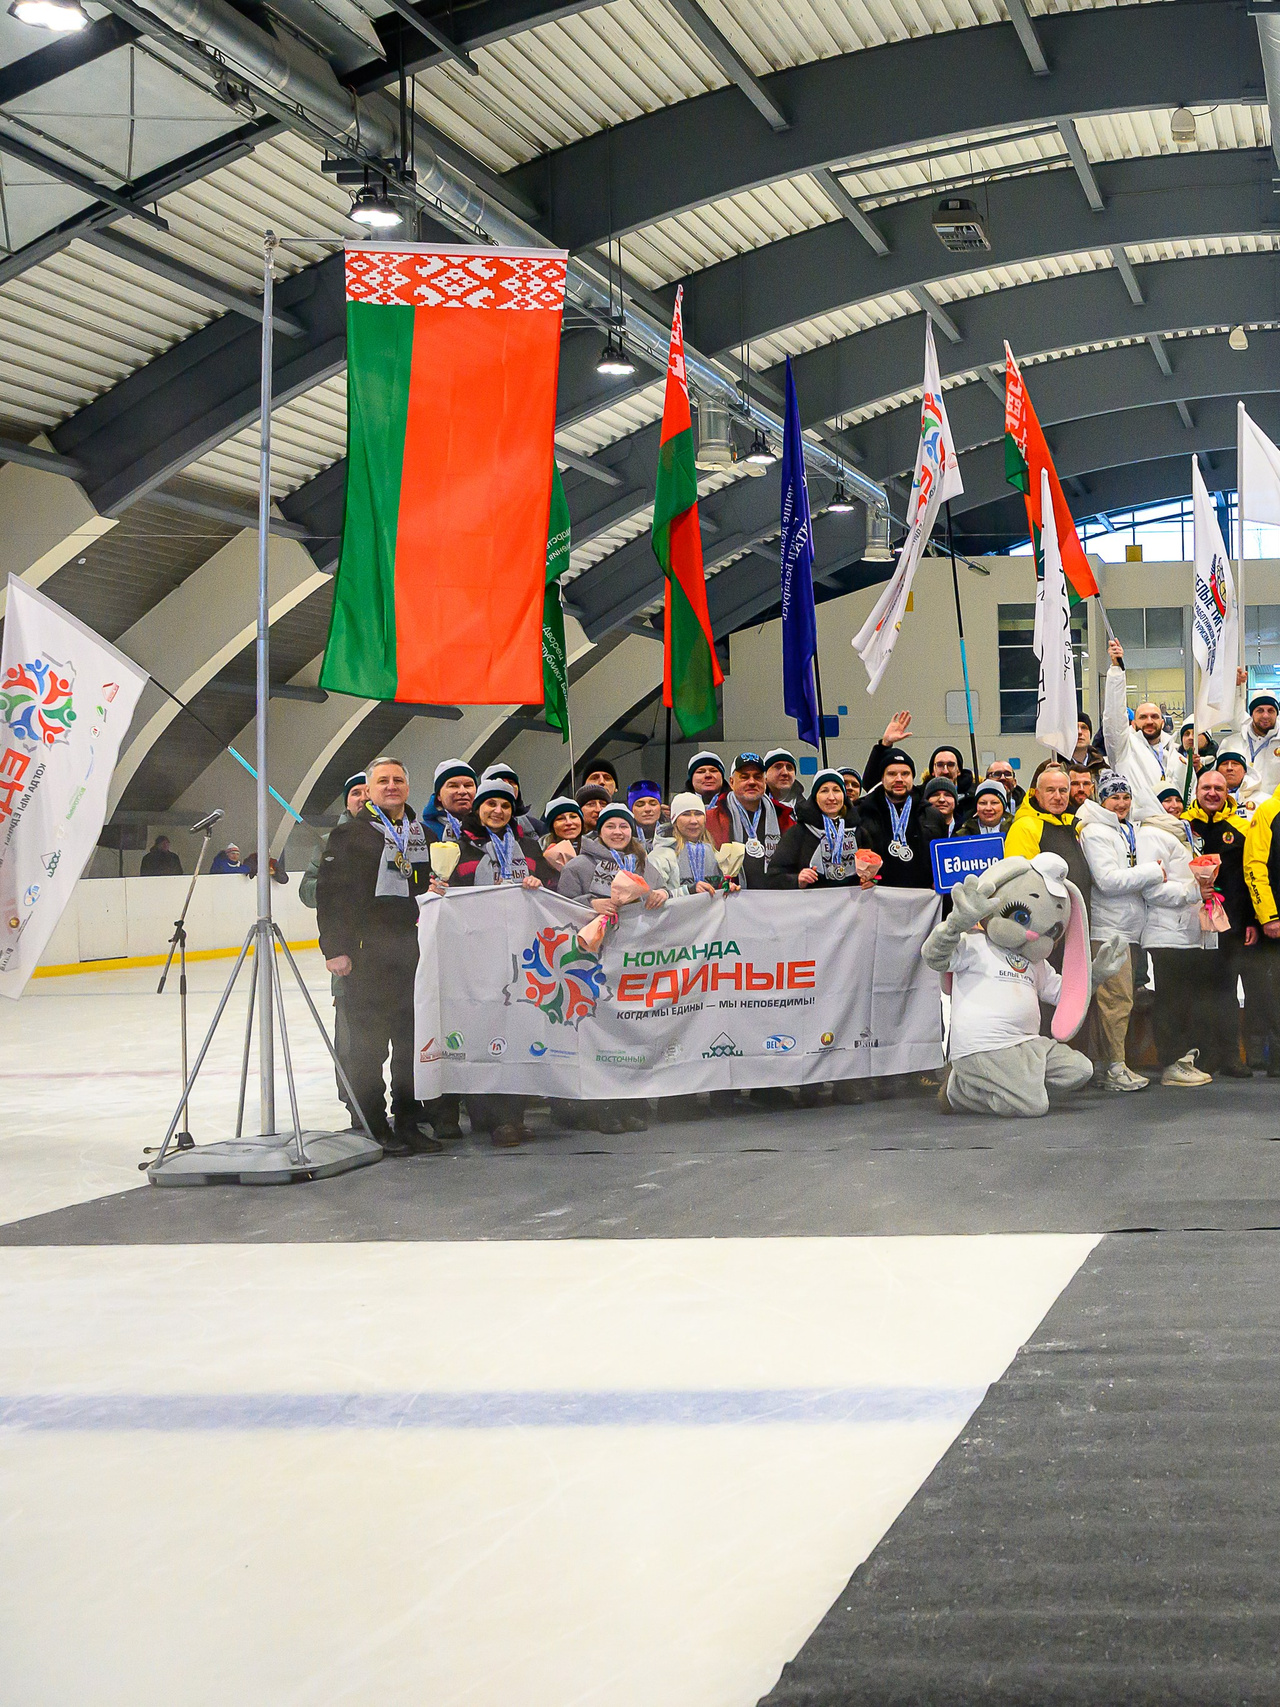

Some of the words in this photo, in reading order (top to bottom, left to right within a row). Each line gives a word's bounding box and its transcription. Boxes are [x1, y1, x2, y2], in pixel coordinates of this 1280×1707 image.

[1196, 573, 1214, 610] ЕЛЫЕ
[1211, 608, 1223, 641] ТИГ
[623, 940, 741, 967] КОМАНДА
[617, 960, 816, 1007] ЕДИНЫЕ
[616, 1010, 649, 1020] КОГДА
[651, 1009, 670, 1018] МЫ
[671, 1002, 704, 1016] ЕДИНЫ
[719, 999, 737, 1008] МЫ
[740, 997, 815, 1009] НЕПОБЕДИМЫ!
[596, 1055, 646, 1063] ВОСТОЧНЫЙ
